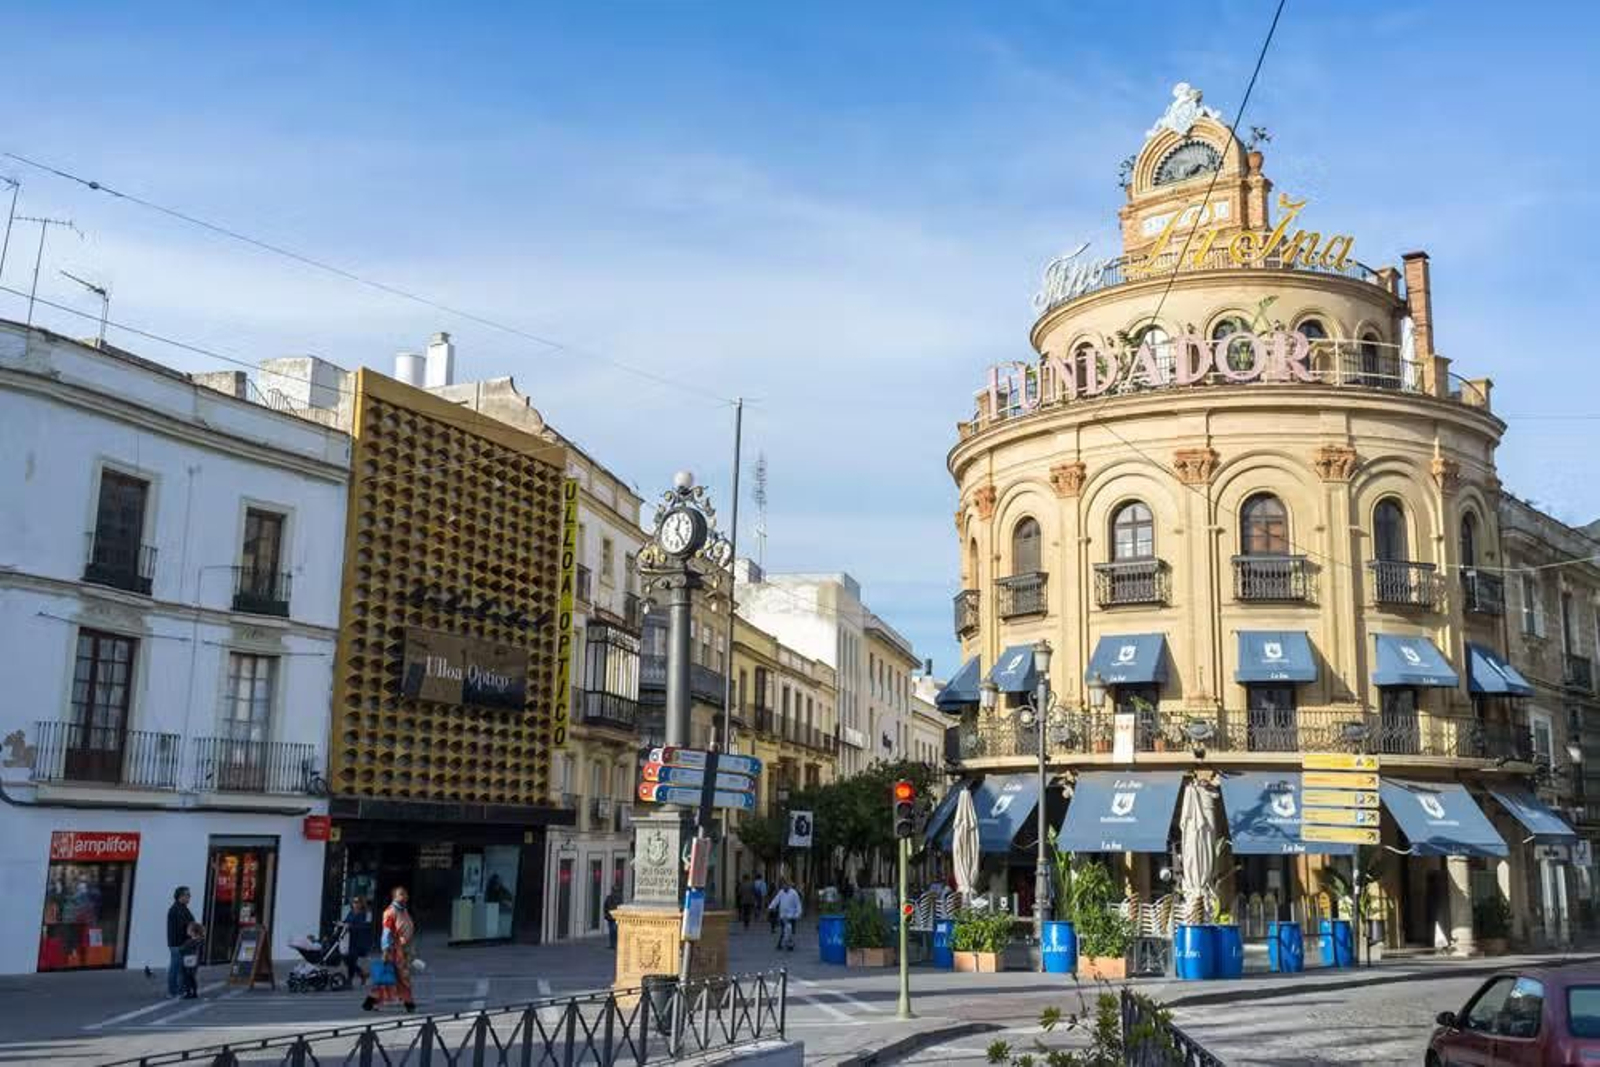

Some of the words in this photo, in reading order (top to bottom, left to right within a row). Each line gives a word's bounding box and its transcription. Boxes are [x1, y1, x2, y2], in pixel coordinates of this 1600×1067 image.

[986, 331, 1322, 419] FUNDADOR
[561, 482, 577, 594] ULLOA
[426, 655, 463, 681] Ulloa
[554, 611, 571, 745] OPTICO
[75, 836, 137, 856] amplifon
